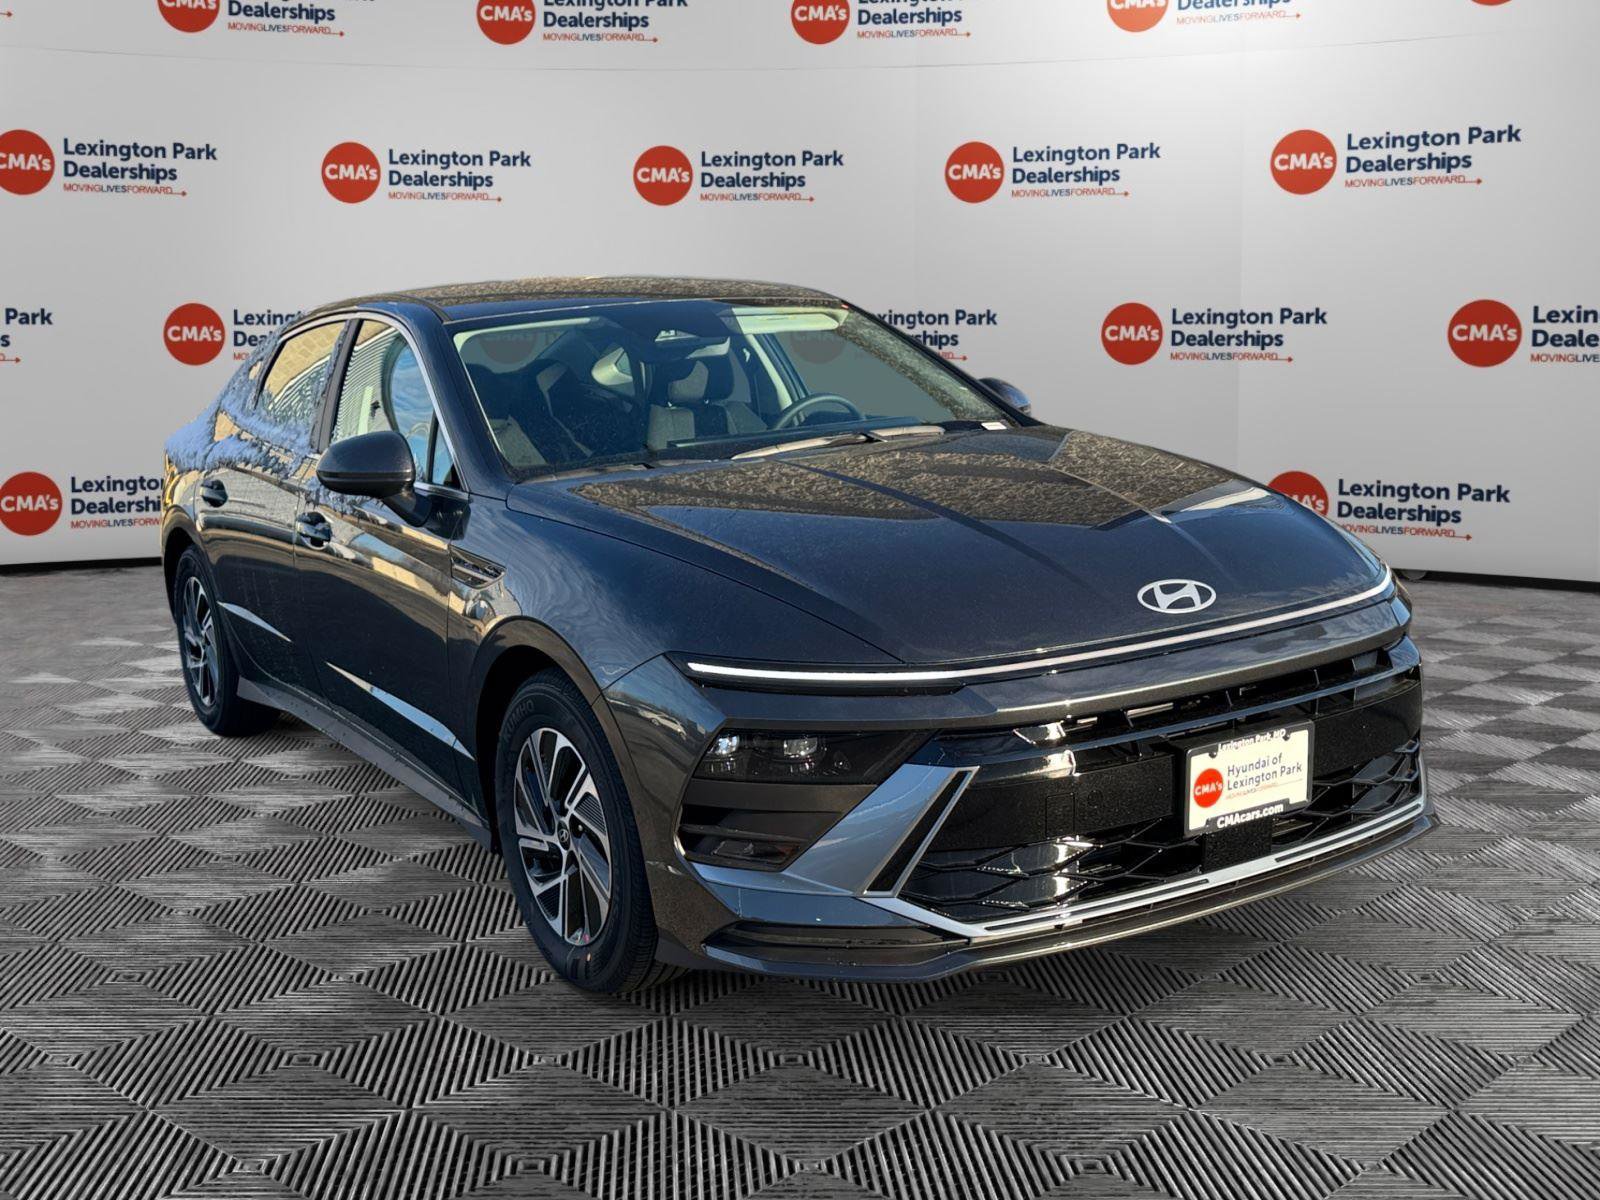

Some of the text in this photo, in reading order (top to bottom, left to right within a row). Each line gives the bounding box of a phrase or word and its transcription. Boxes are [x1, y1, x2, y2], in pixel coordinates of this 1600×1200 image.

[228, 0, 335, 24] Dealerships
[480, 5, 533, 21] CMA's
[543, 12, 649, 31] Dealerships
[794, 5, 847, 21] CMA's
[857, 7, 962, 26] Dealerships
[1347, 124, 1521, 152] Lexington Park
[63, 138, 217, 161] Lexington Park
[1013, 142, 1161, 165] Lexington Park
[388, 149, 531, 170] Lexington Park
[701, 150, 844, 171] Lexington Park
[1274, 152, 1333, 170] CMA's
[1346, 152, 1472, 174] Dealerships
[63, 161, 177, 184] Dealerships
[325, 164, 378, 180] CMA's
[388, 171, 493, 190] Dealerships
[636, 167, 690, 183] CMA's
[949, 163, 1002, 180] CMA's
[1012, 167, 1120, 186] Dealerships
[701, 172, 806, 191] Dealerships
[5, 308, 53, 325] Park
[233, 309, 302, 326] Lexin
[955, 309, 997, 325] Park
[1172, 307, 1327, 328] Lexington Park
[1533, 304, 1600, 324] Lexin
[167, 325, 222, 342] CMA's
[1105, 325, 1159, 342] CMA's
[1171, 330, 1283, 350] Dealerships
[1452, 323, 1518, 342] CMA's
[1530, 353, 1600, 363] MOVINGLIVE
[1338, 478, 1510, 503] Lexington Park
[1, 494, 59, 512] CMA's
[71, 496, 161, 515] Dealershi
[1337, 500, 1462, 526] Dealerships
[71, 517, 160, 529] MOVINGLIVESFORW
[1227, 753, 1282, 778] Hyundai of
[1227, 770, 1278, 791] Lexington
[1280, 762, 1302, 777] Park
[1194, 780, 1223, 797] CMA's
[1217, 804, 1284, 828] CMAcars.com
